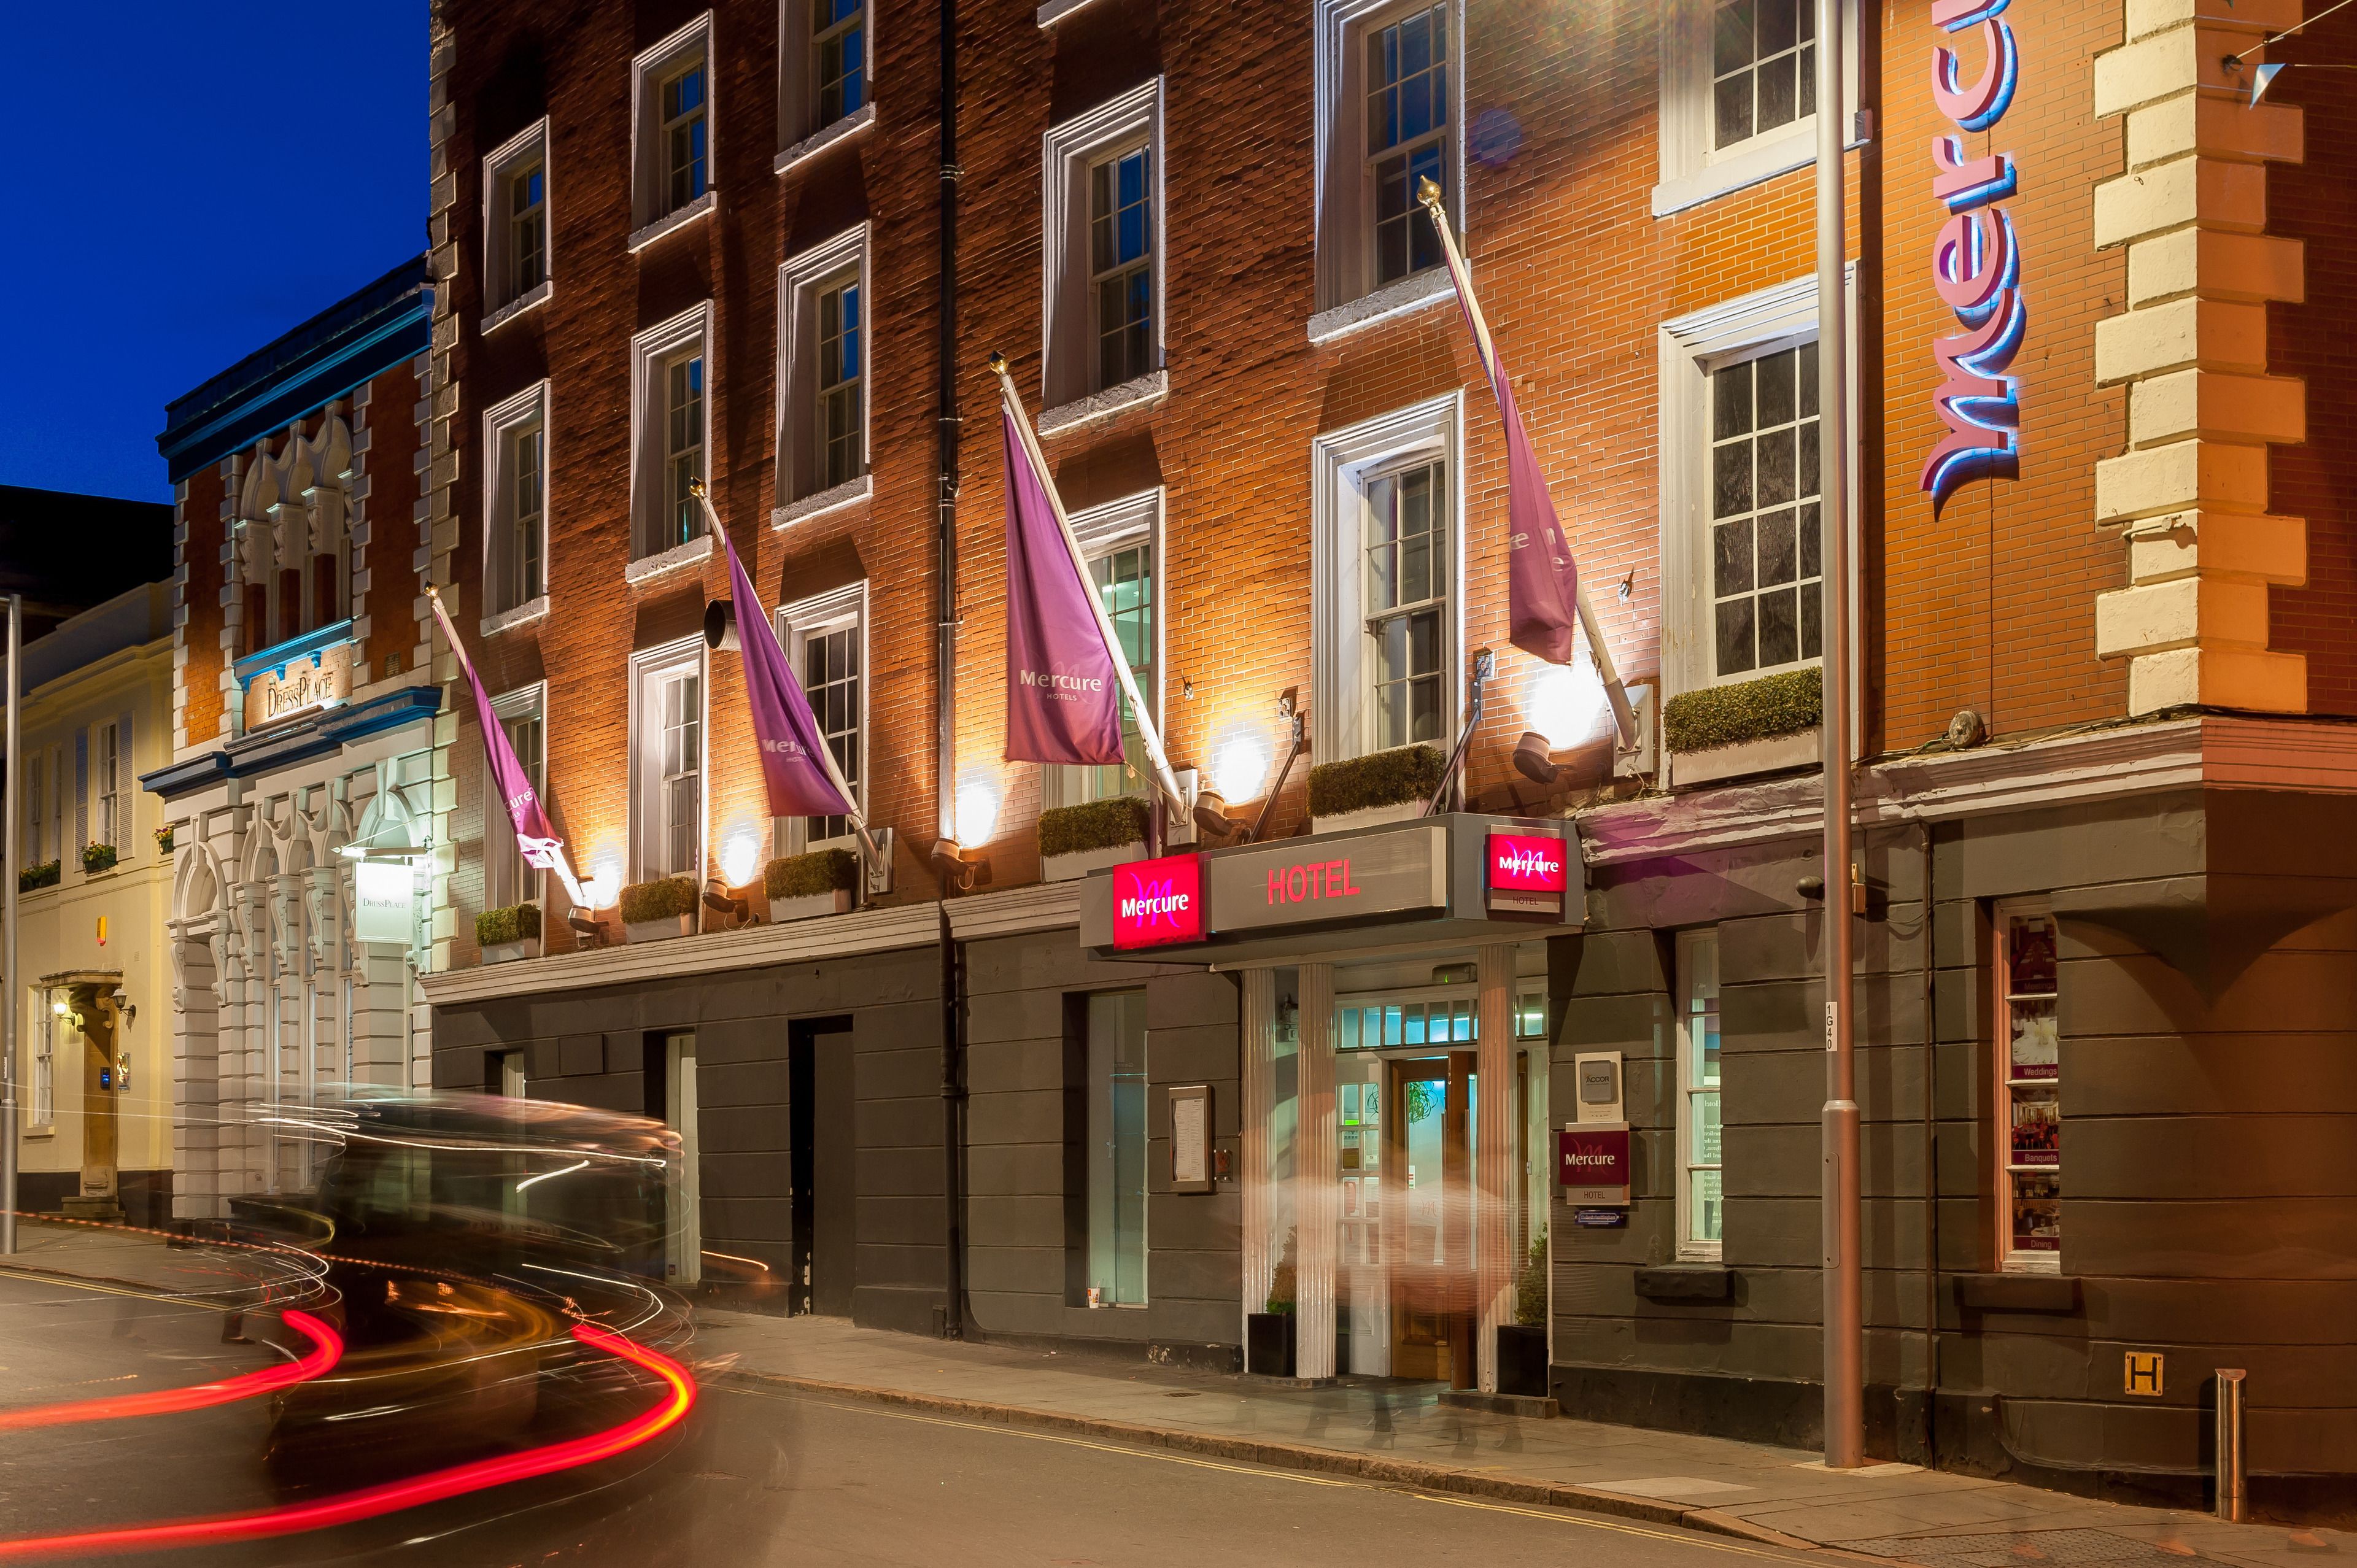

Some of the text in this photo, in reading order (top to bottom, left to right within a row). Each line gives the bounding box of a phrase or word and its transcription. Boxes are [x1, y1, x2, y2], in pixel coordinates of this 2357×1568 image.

[1020, 670, 1102, 692] Mercure
[1047, 693, 1078, 701] HOTELS
[1499, 857, 1559, 873] Mercure
[1268, 858, 1361, 905] HOTEL
[1122, 894, 1189, 917] Mercure
[1512, 896, 1539, 905] HOTEL
[2024, 1068, 2057, 1077] Weddings
[1565, 1153, 1615, 1166] Mercure
[2025, 1154, 2057, 1163] Banquets
[1584, 1191, 1606, 1199] HOTEL
[2030, 1240, 2052, 1249] Dining
[2131, 1356, 2158, 1391] H
